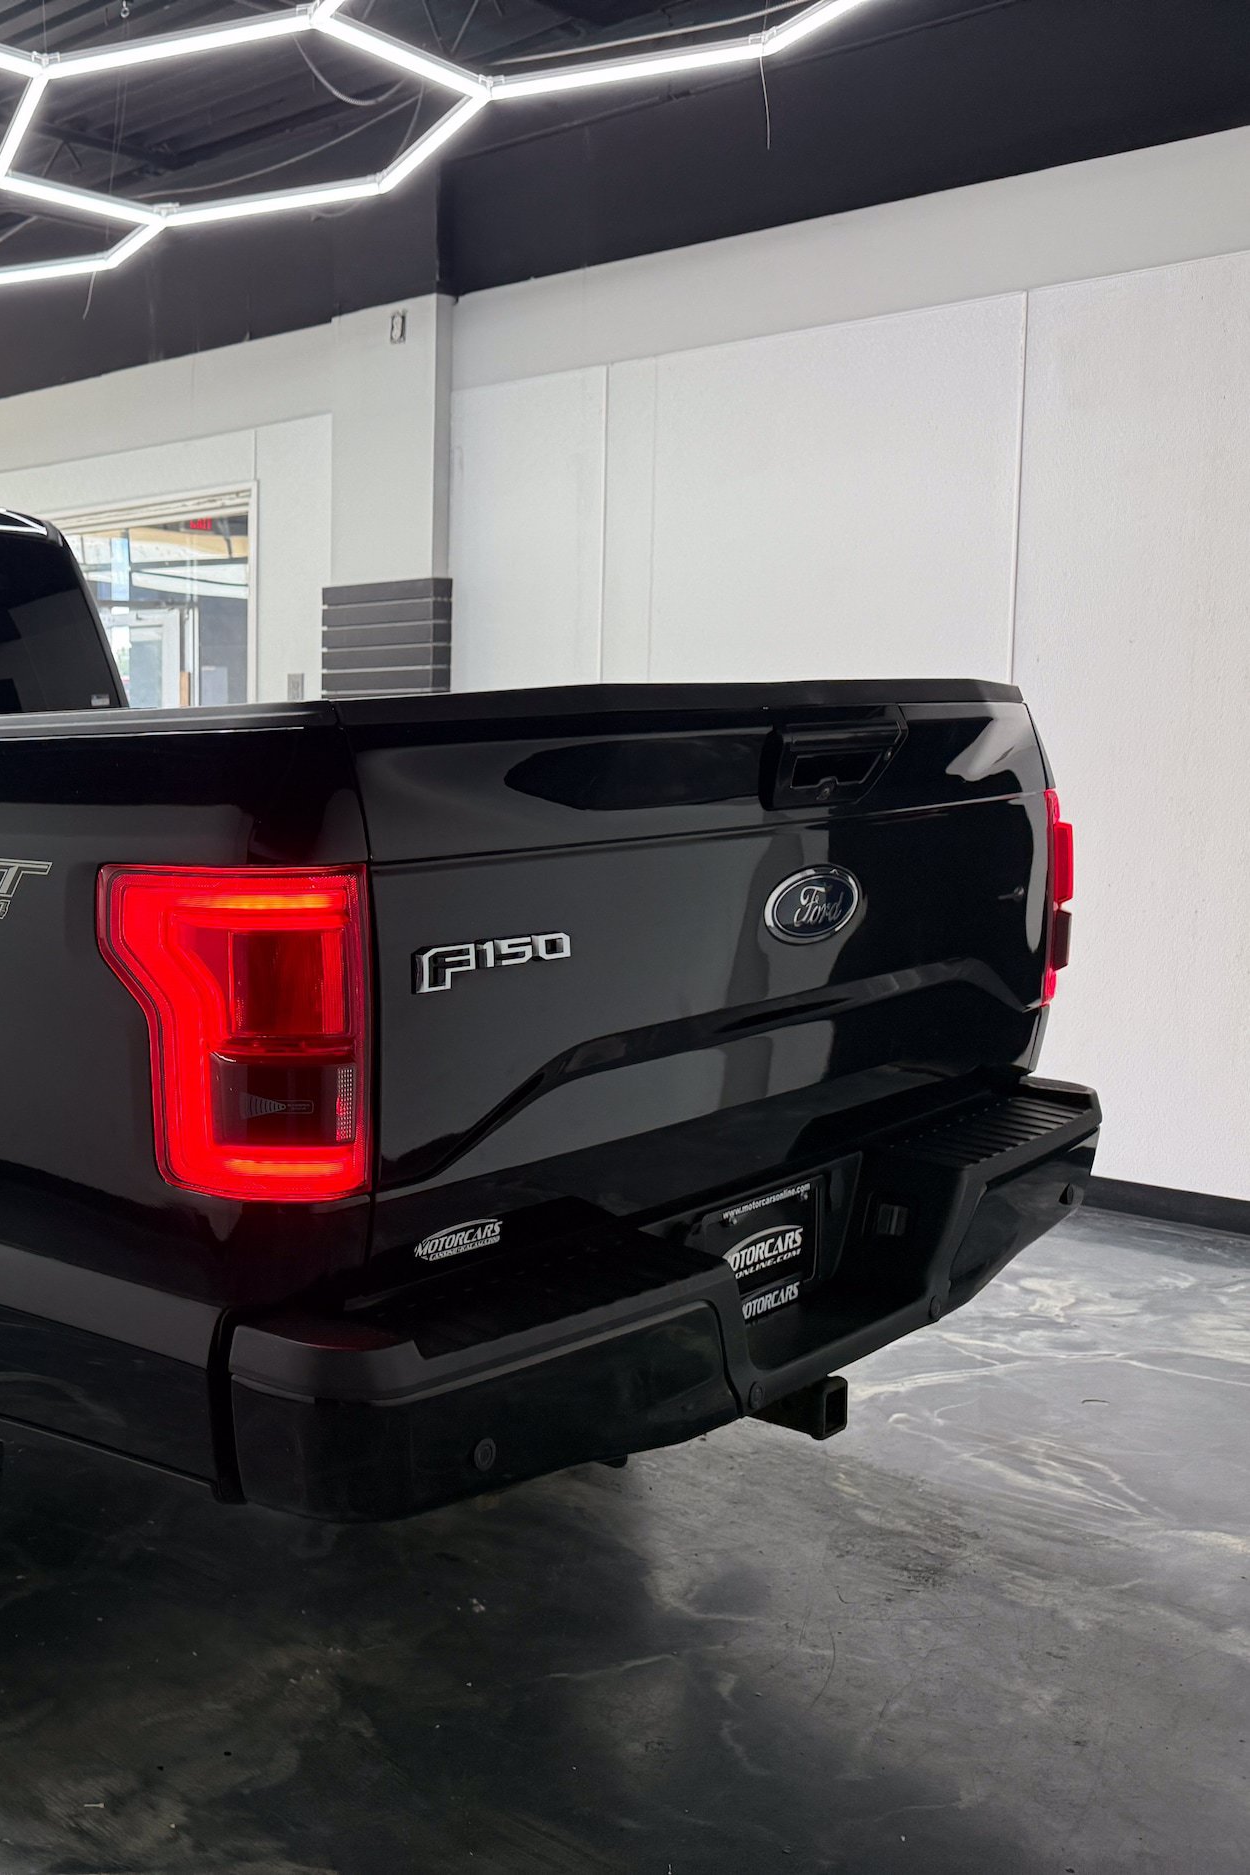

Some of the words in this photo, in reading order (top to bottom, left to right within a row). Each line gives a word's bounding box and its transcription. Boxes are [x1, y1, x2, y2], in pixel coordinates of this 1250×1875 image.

[793, 885, 845, 928] Ford
[722, 1182, 811, 1220] www.motorcarsonline.com
[414, 1219, 503, 1258] MOTORCARS
[728, 1228, 804, 1275] OTORCARS
